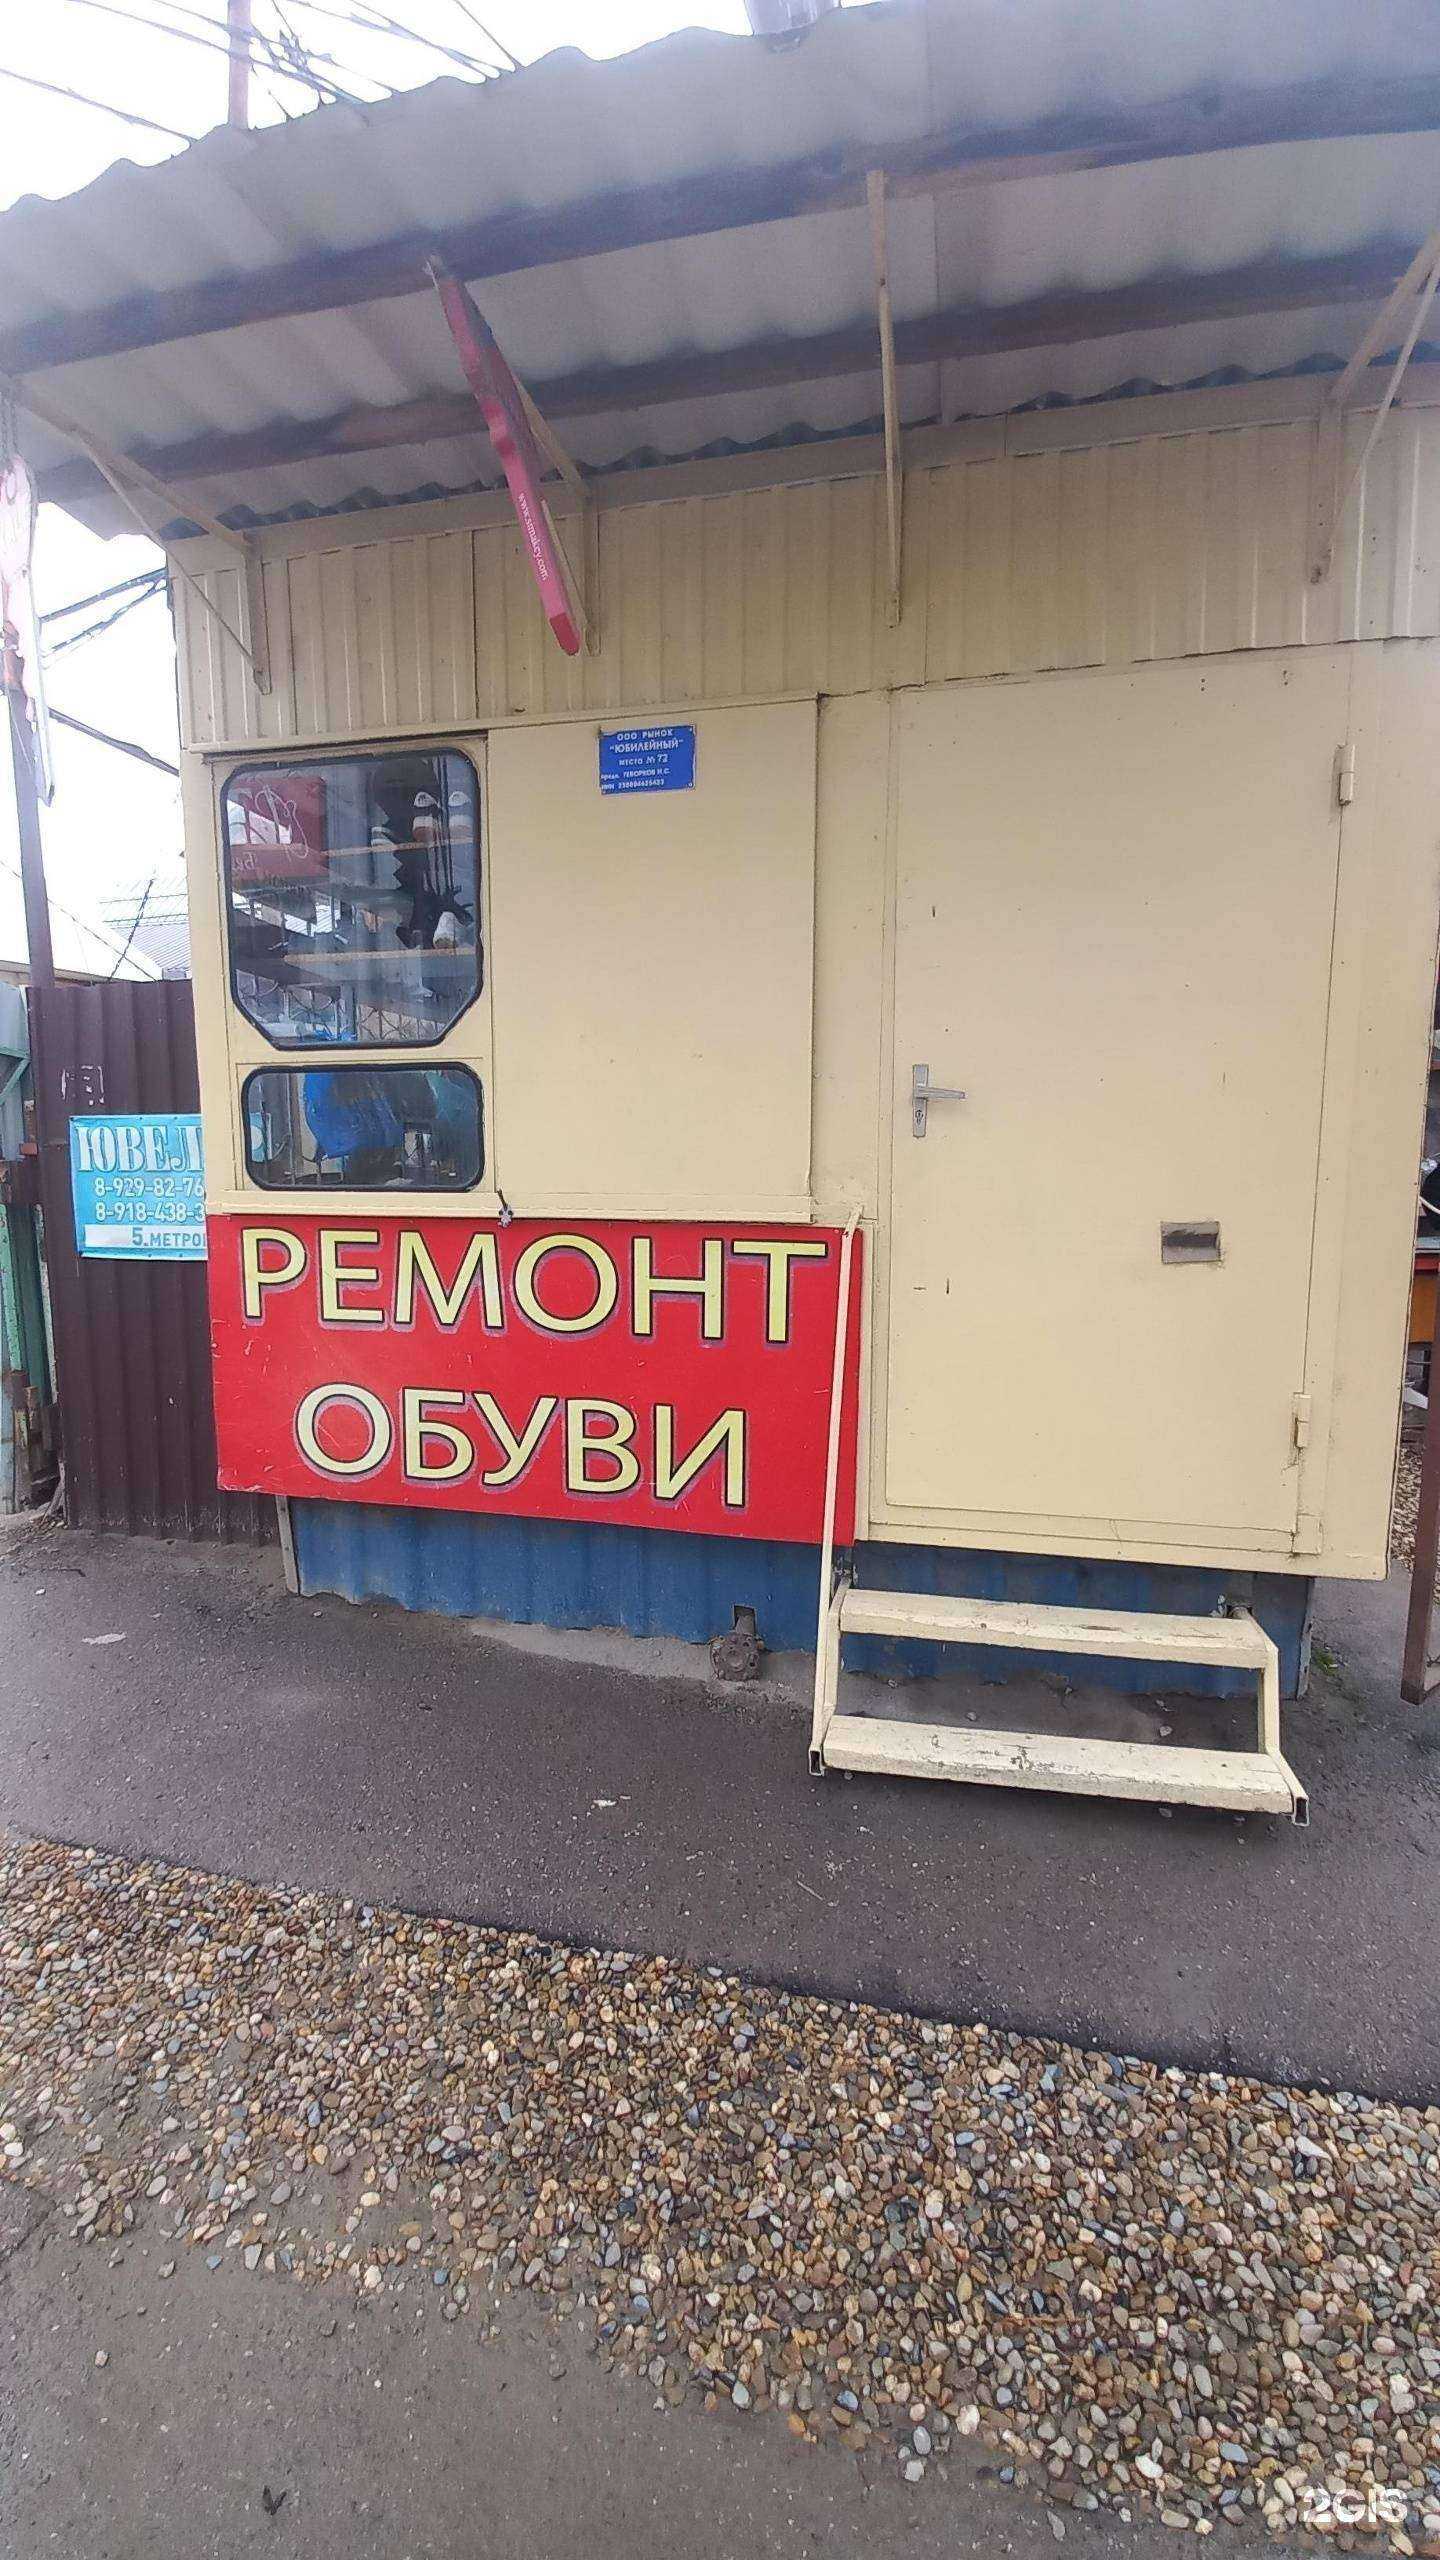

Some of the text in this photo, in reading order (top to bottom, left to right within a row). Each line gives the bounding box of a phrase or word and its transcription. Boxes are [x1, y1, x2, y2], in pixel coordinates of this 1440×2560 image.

[616, 728, 673, 742] ООО РЫНОК
[241, 1227, 828, 1344] РЕМОНТ
[295, 1383, 748, 1508] ОБУВИ
